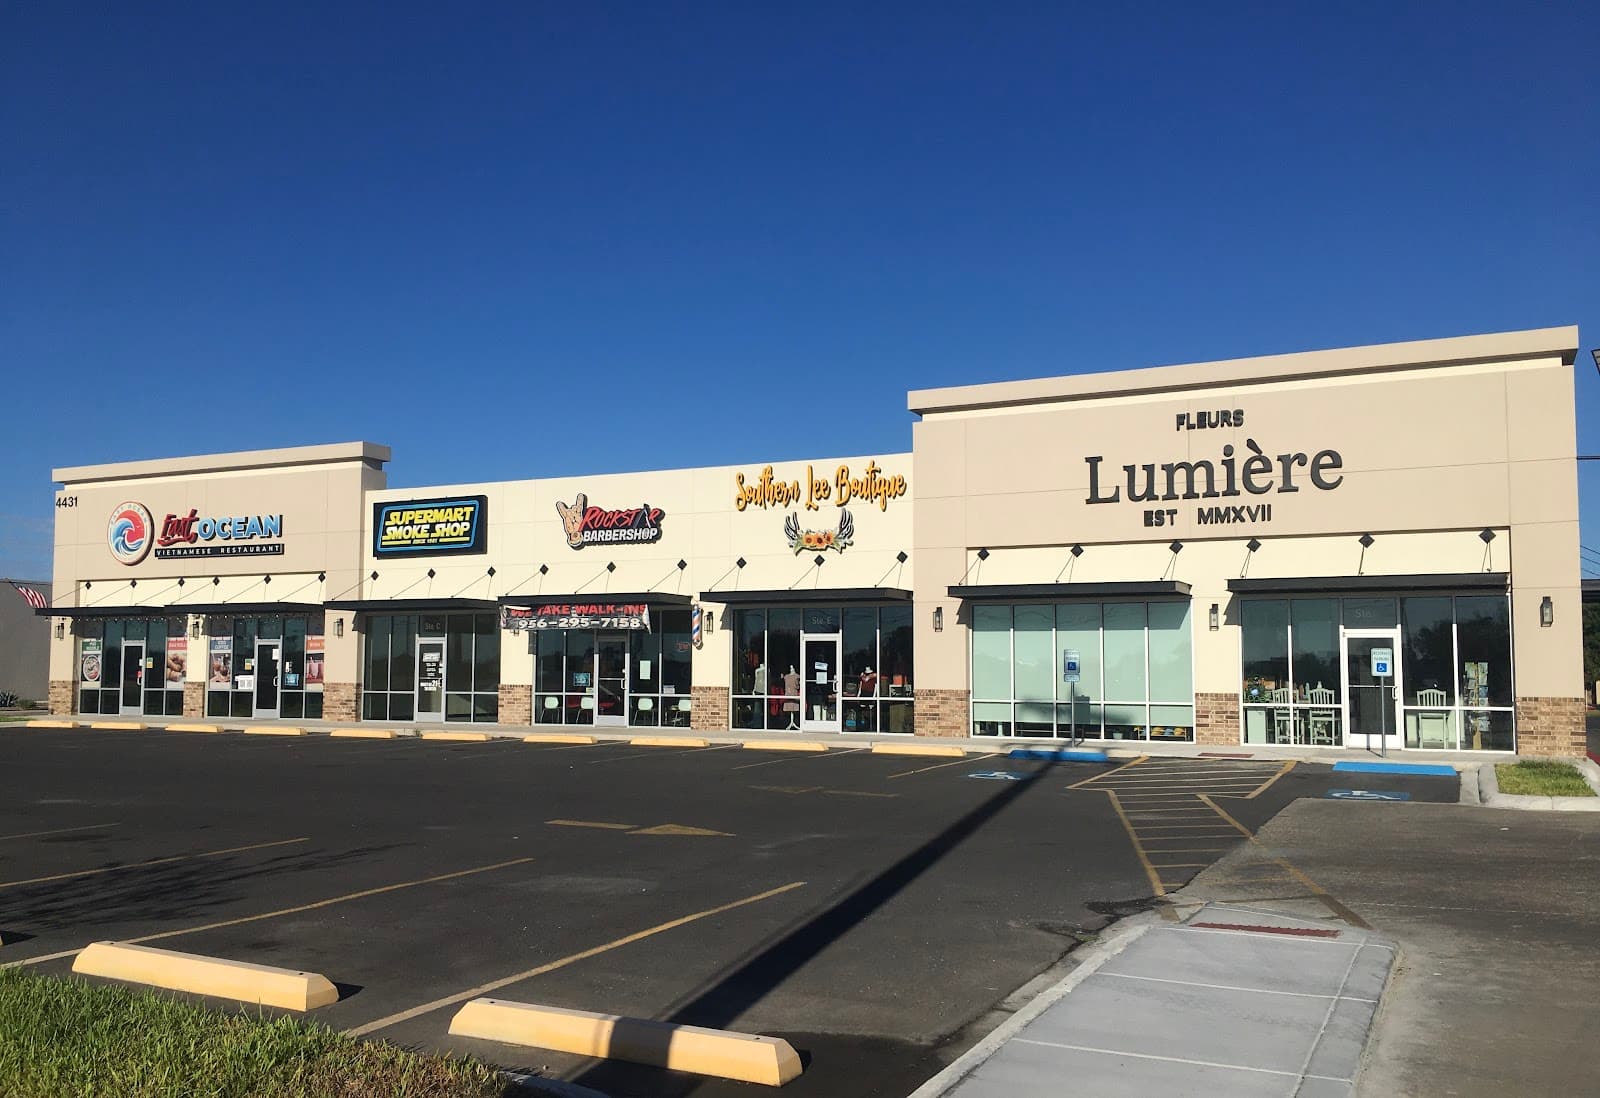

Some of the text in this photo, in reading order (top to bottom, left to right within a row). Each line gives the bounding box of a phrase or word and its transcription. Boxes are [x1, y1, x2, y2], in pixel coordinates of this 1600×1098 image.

[1176, 409, 1244, 431] FLEURS
[1084, 438, 1344, 505] Lumière
[736, 460, 907, 512] Southern Lee Boutique
[55, 496, 78, 508] 4431
[385, 507, 475, 526] SUPERMART
[578, 504, 660, 531] ROCKSTAR
[1143, 504, 1272, 527] EST MMXVII
[197, 514, 283, 541] OCEAN
[382, 522, 470, 541] SMOKE SHOP
[583, 527, 658, 542] BARBERSHOP
[156, 545, 280, 556] VIETNAMESE RESTAURANT
[518, 617, 641, 630] 956-295-7158
